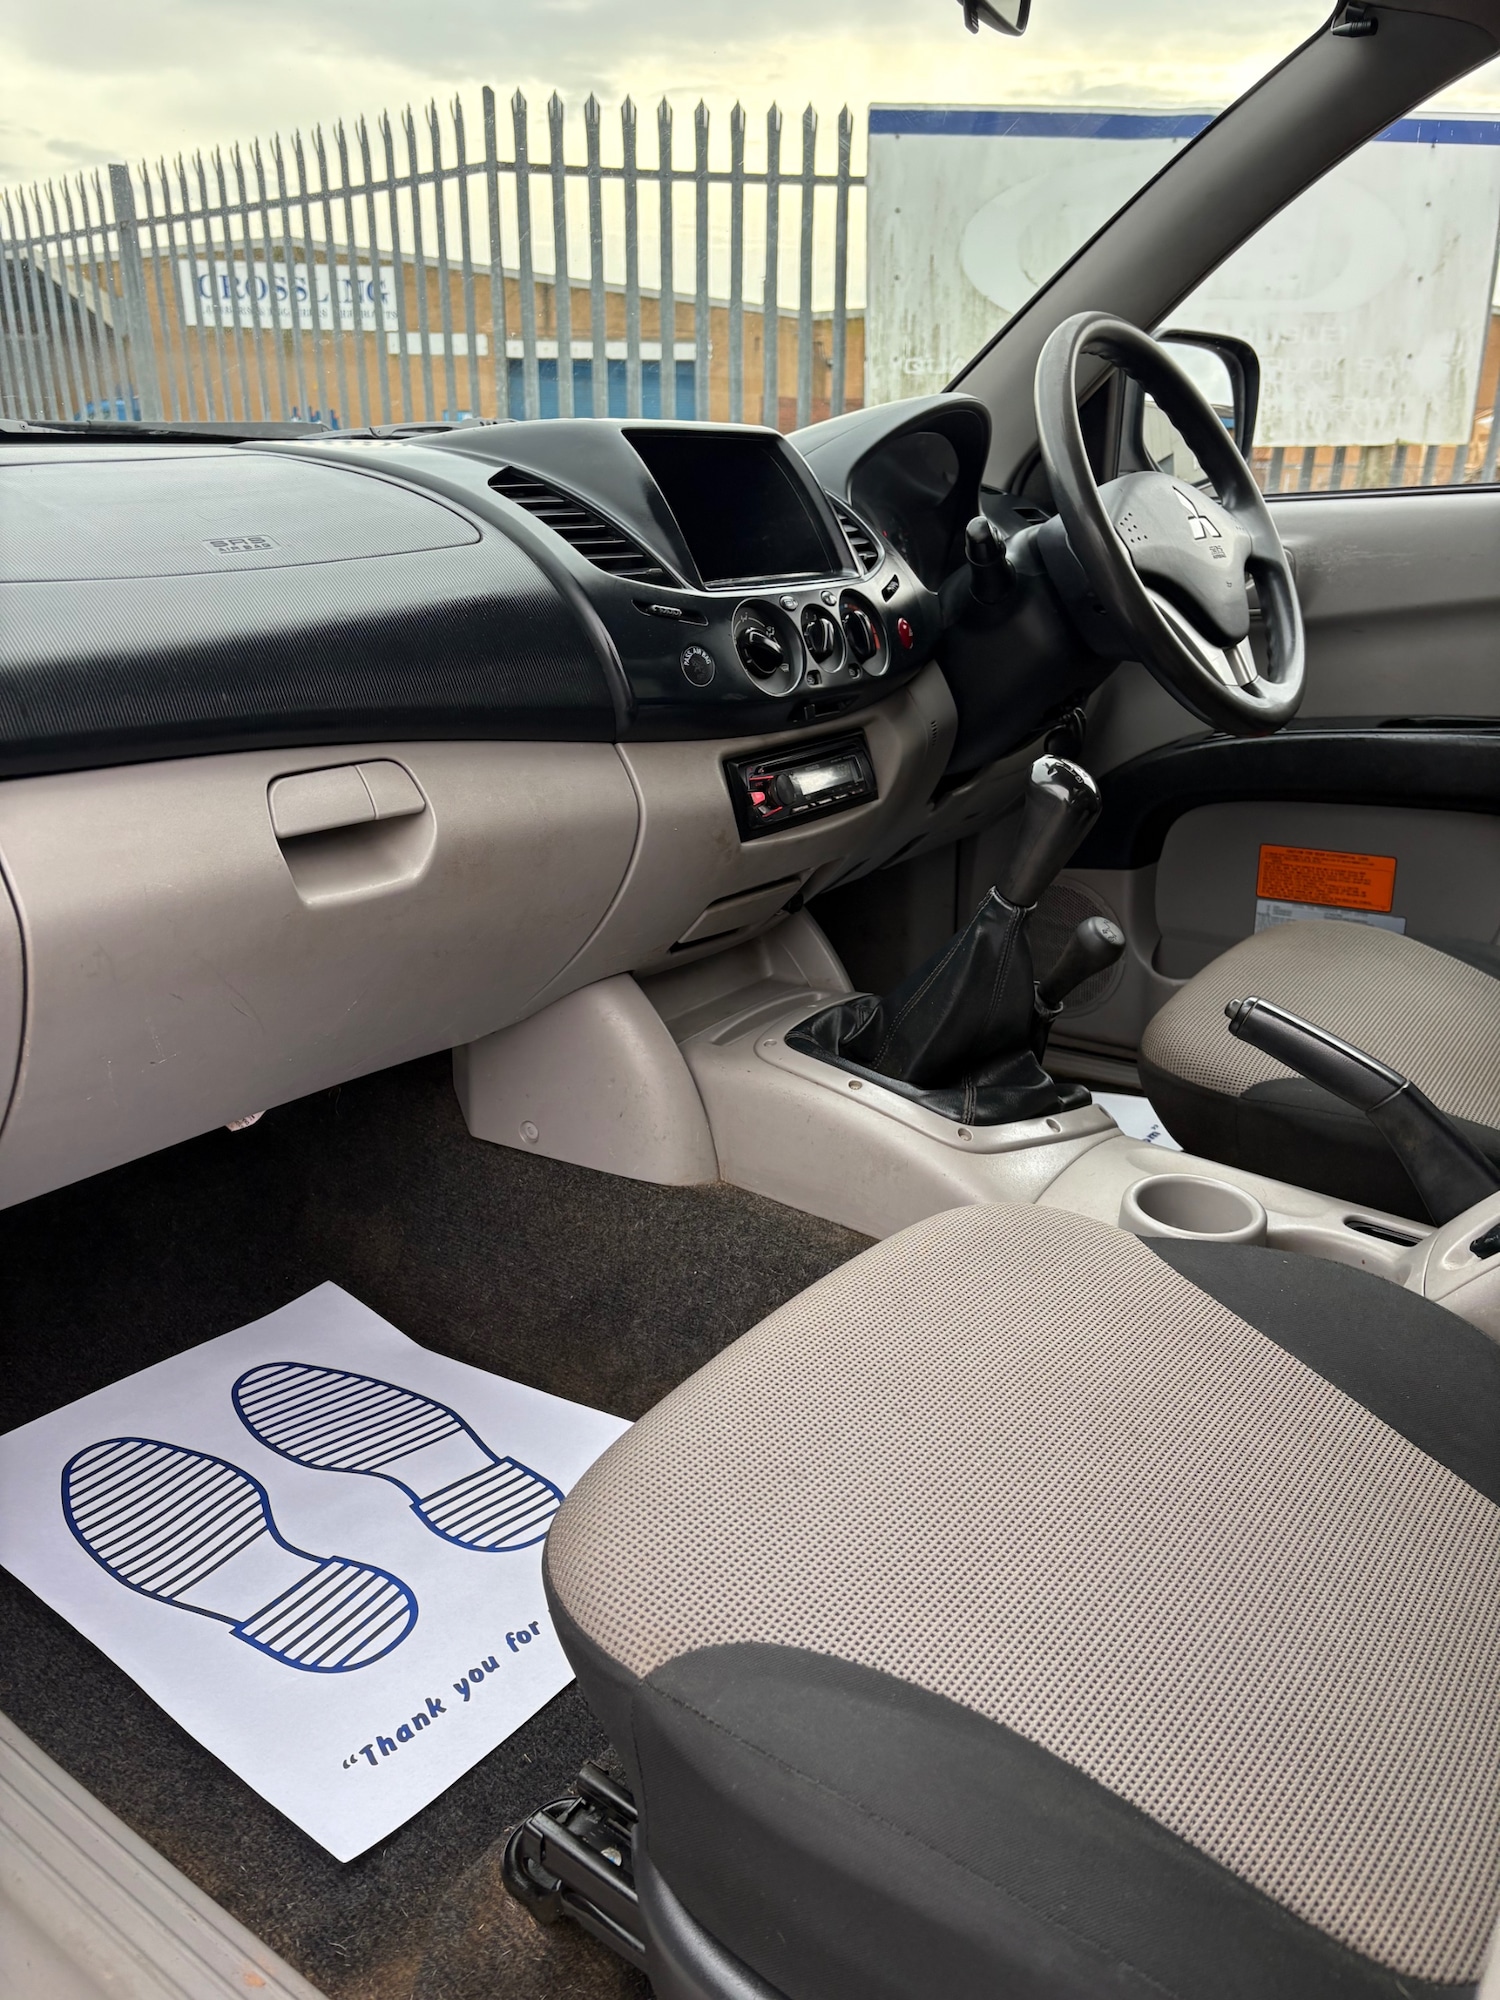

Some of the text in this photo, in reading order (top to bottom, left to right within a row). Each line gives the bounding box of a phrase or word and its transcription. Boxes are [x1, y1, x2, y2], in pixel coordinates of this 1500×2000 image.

[197, 274, 388, 304] CROSSLNG
[453, 1655, 501, 1702] you
[505, 1620, 541, 1653] for
